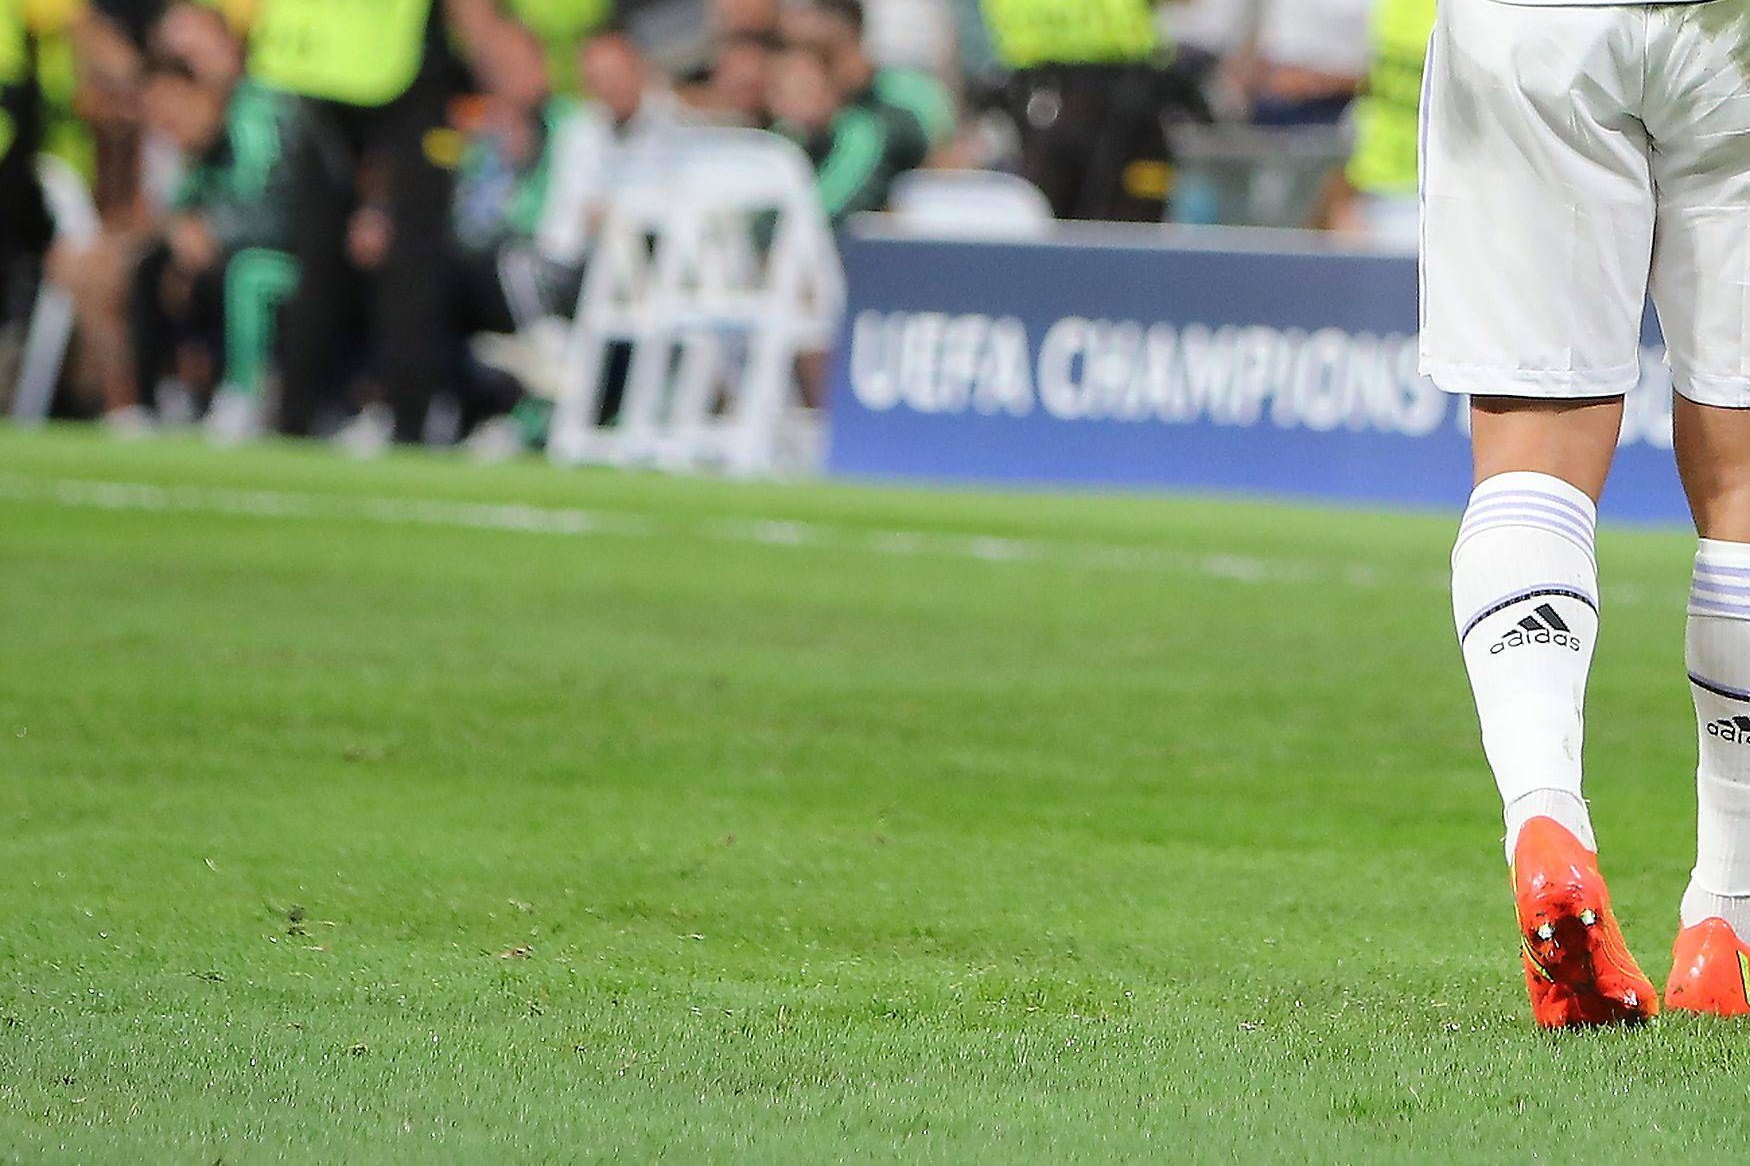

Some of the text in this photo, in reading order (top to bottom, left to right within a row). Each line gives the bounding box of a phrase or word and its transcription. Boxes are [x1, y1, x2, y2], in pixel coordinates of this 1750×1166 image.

[851, 309, 1034, 417] UEFA
[1038, 313, 1448, 438] CHAMPIONS
[1489, 627, 1582, 655] adidas
